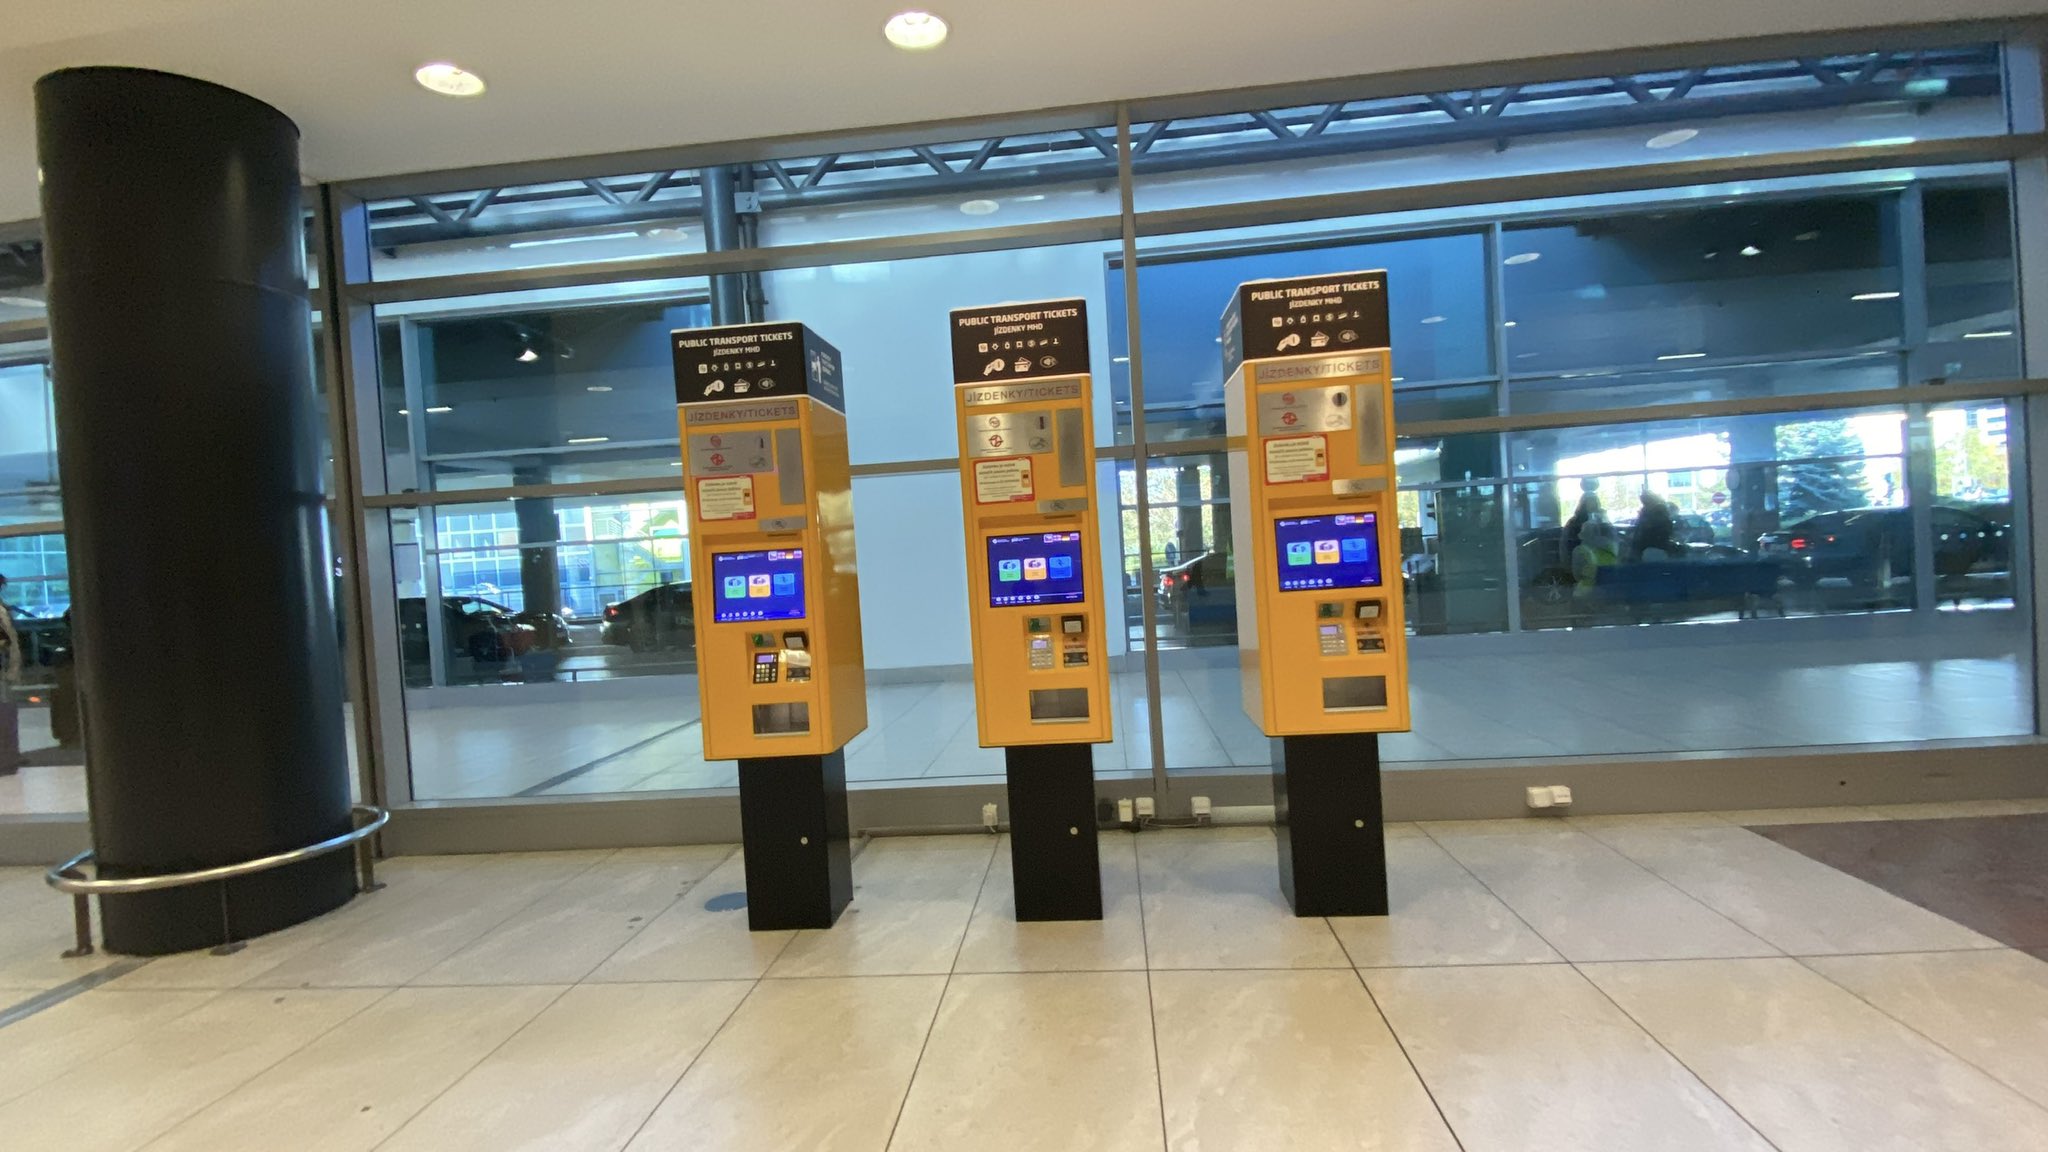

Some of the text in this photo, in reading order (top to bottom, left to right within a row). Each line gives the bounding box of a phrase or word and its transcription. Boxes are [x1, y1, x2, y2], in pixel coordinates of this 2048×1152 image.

[1251, 280, 1380, 301] PUBLIC TRANSPORT TICKETS
[958, 308, 1078, 327] PUBLIC TRANSPORT TICKETS
[679, 332, 793, 348] PUBLIC TRANSPORT TICKETS
